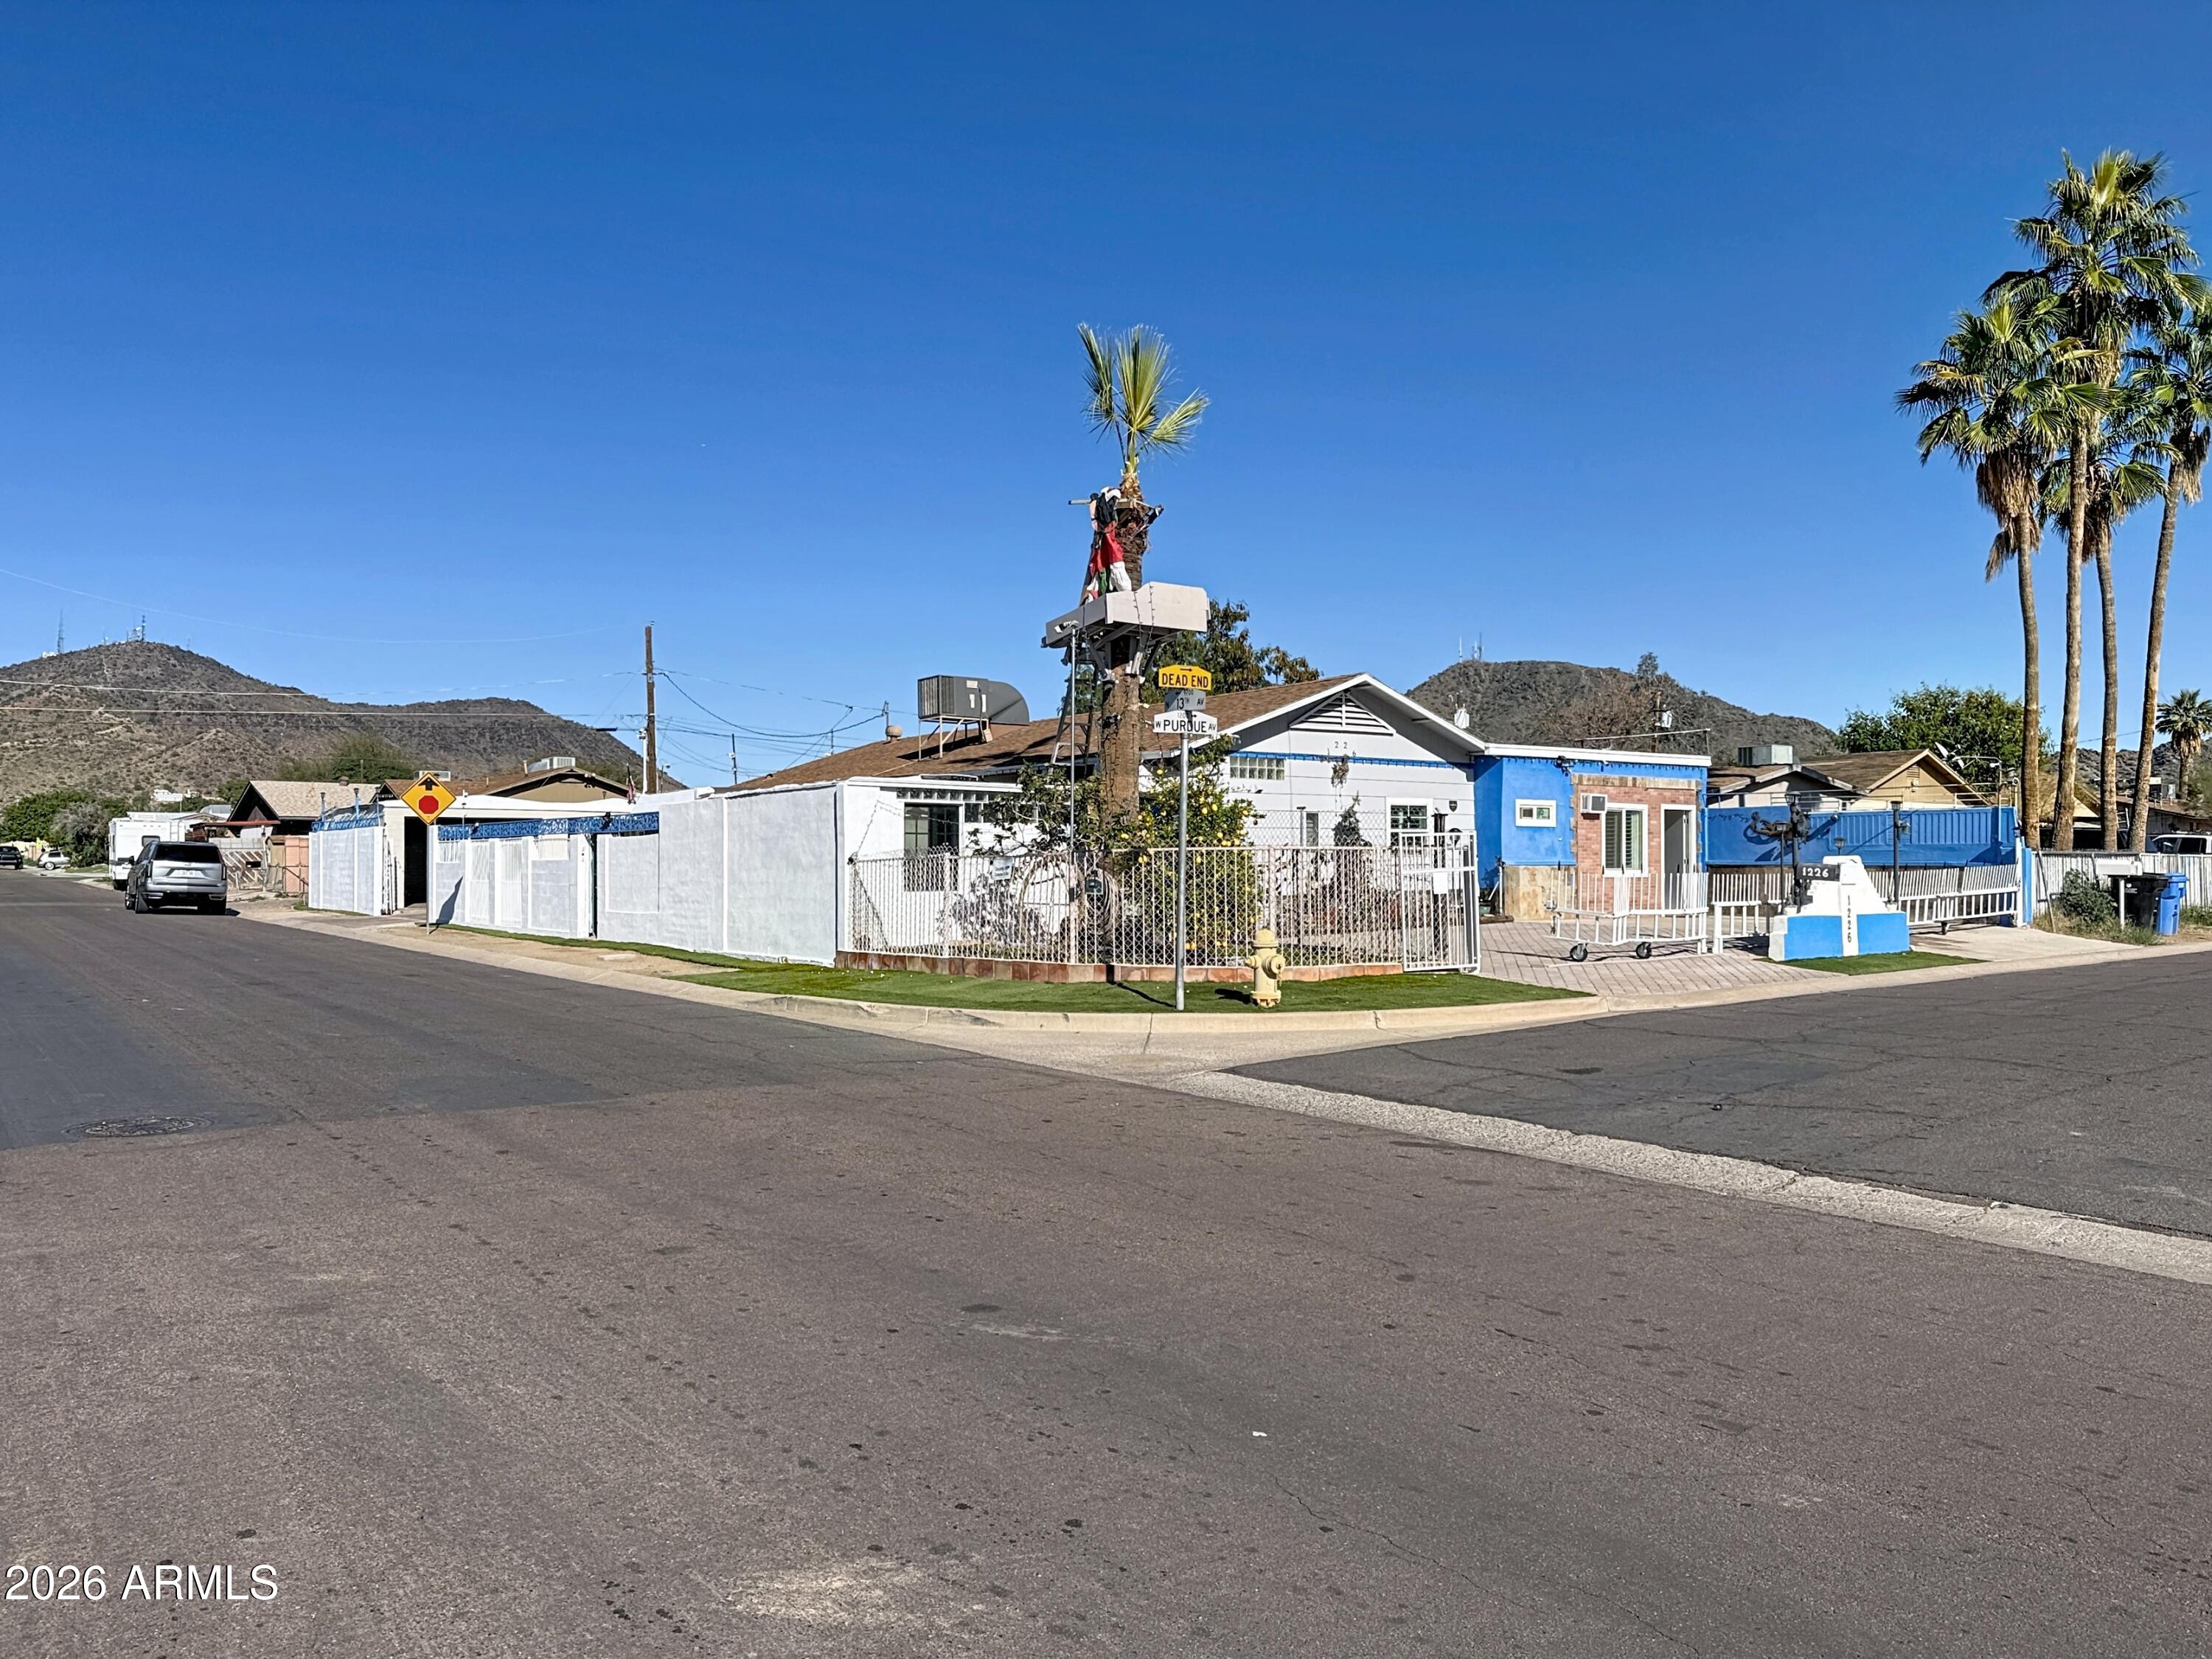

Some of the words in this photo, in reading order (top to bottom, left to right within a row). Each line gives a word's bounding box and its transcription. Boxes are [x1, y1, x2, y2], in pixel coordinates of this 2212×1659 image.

[1162, 673, 1188, 686] DEAD
[1192, 675, 1208, 688] END
[1197, 698, 1204, 706] AV
[1164, 720, 1207, 733] PURDUE
[1802, 866, 1829, 878] 1226
